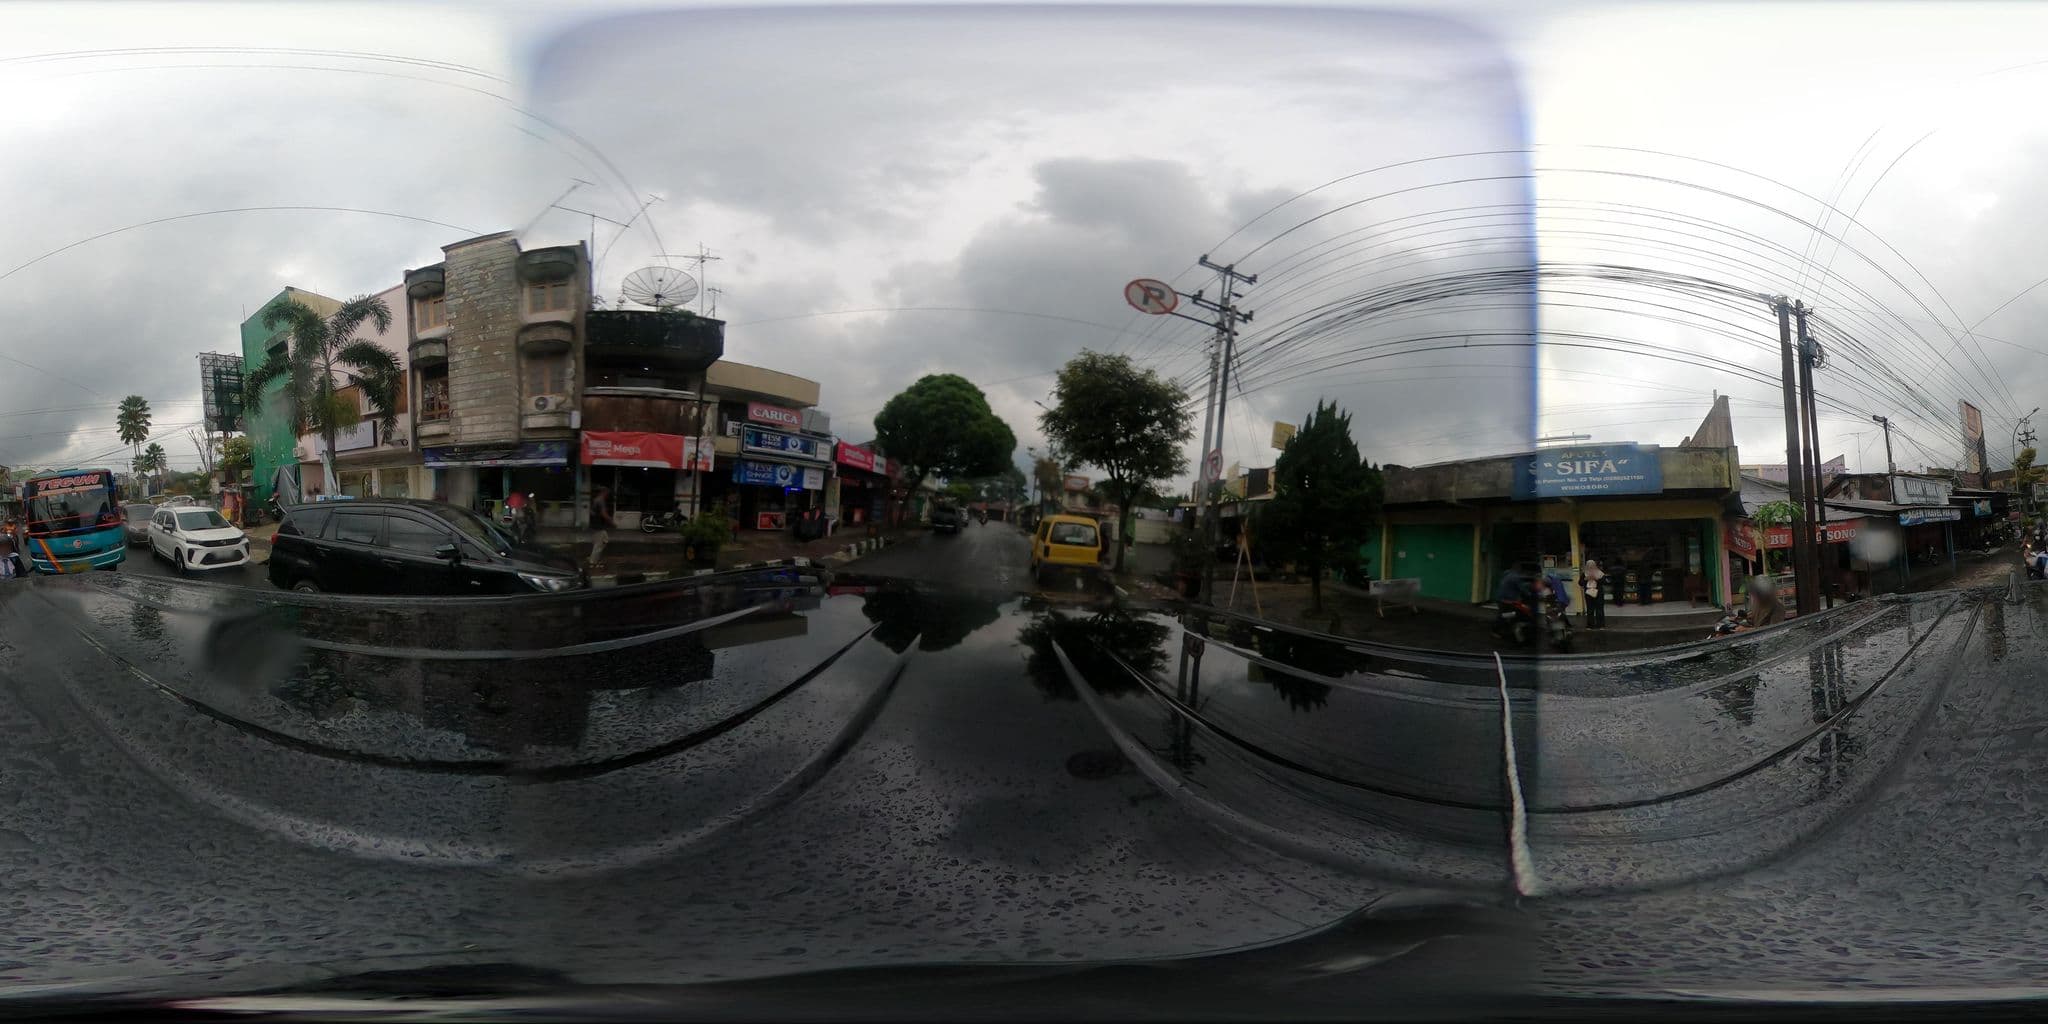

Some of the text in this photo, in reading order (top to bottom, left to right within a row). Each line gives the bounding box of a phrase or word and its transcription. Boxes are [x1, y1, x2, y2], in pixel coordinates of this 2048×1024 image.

[753, 407, 798, 424] CARICA
[614, 444, 640, 456] Mega
[1770, 534, 1788, 545] BU
